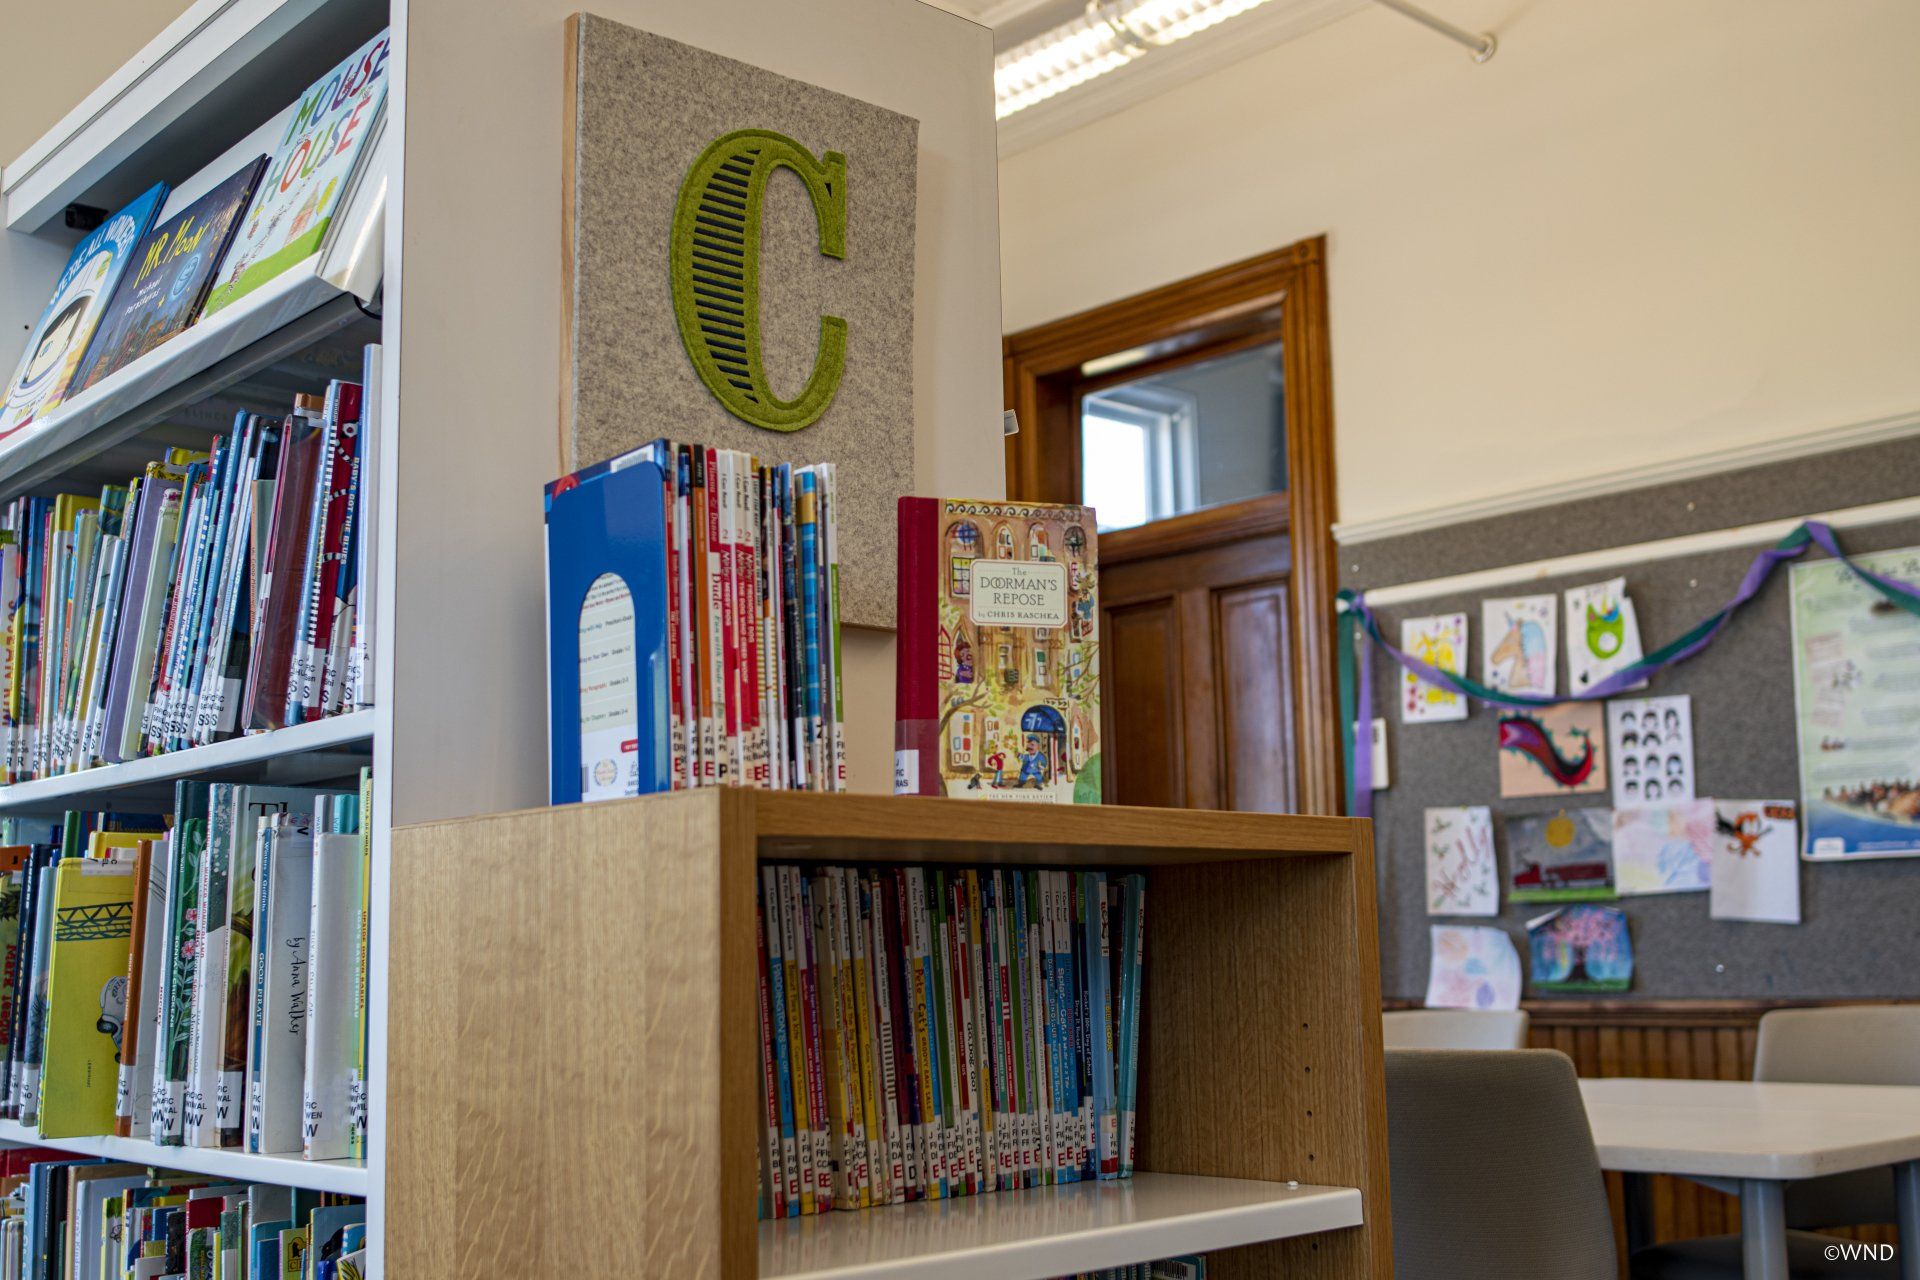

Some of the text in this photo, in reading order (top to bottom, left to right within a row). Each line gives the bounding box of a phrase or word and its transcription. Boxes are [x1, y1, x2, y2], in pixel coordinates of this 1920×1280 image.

[285, 36, 389, 147] MOUSE
[258, 95, 372, 209] HOUSE
[669, 128, 847, 433] C
[340, 457, 359, 564] BABY'S GOT THE BLUES
[980, 577, 1058, 591] DOORMAN'S
[1012, 567, 1028, 576] The
[710, 572, 724, 609] Dude
[993, 593, 1045, 606] REPOSE
[1017, 612, 1060, 620] RASCHKA
[4, 943, 17, 990] Mark
[357, 911, 368, 1009] UPSIDE DOWN BABIES
[254, 952, 265, 1026] GOOD PIRATE
[285, 937, 308, 1036] by Anna Walker
[913, 968, 925, 994] Pete
[1056, 967, 1065, 999] Splat
[770, 962, 788, 1043] PADDINGTON'S
[779, 1043, 787, 1058] Day
[917, 1003, 928, 1032] Cat's
[969, 1070, 977, 1092] Go!
[216, 1106, 229, 1119] W
[305, 1124, 318, 1137] W
[774, 1173, 781, 1184] E
[804, 1168, 812, 1183] E
[894, 1164, 902, 1179] E
[790, 1180, 798, 1194] E
